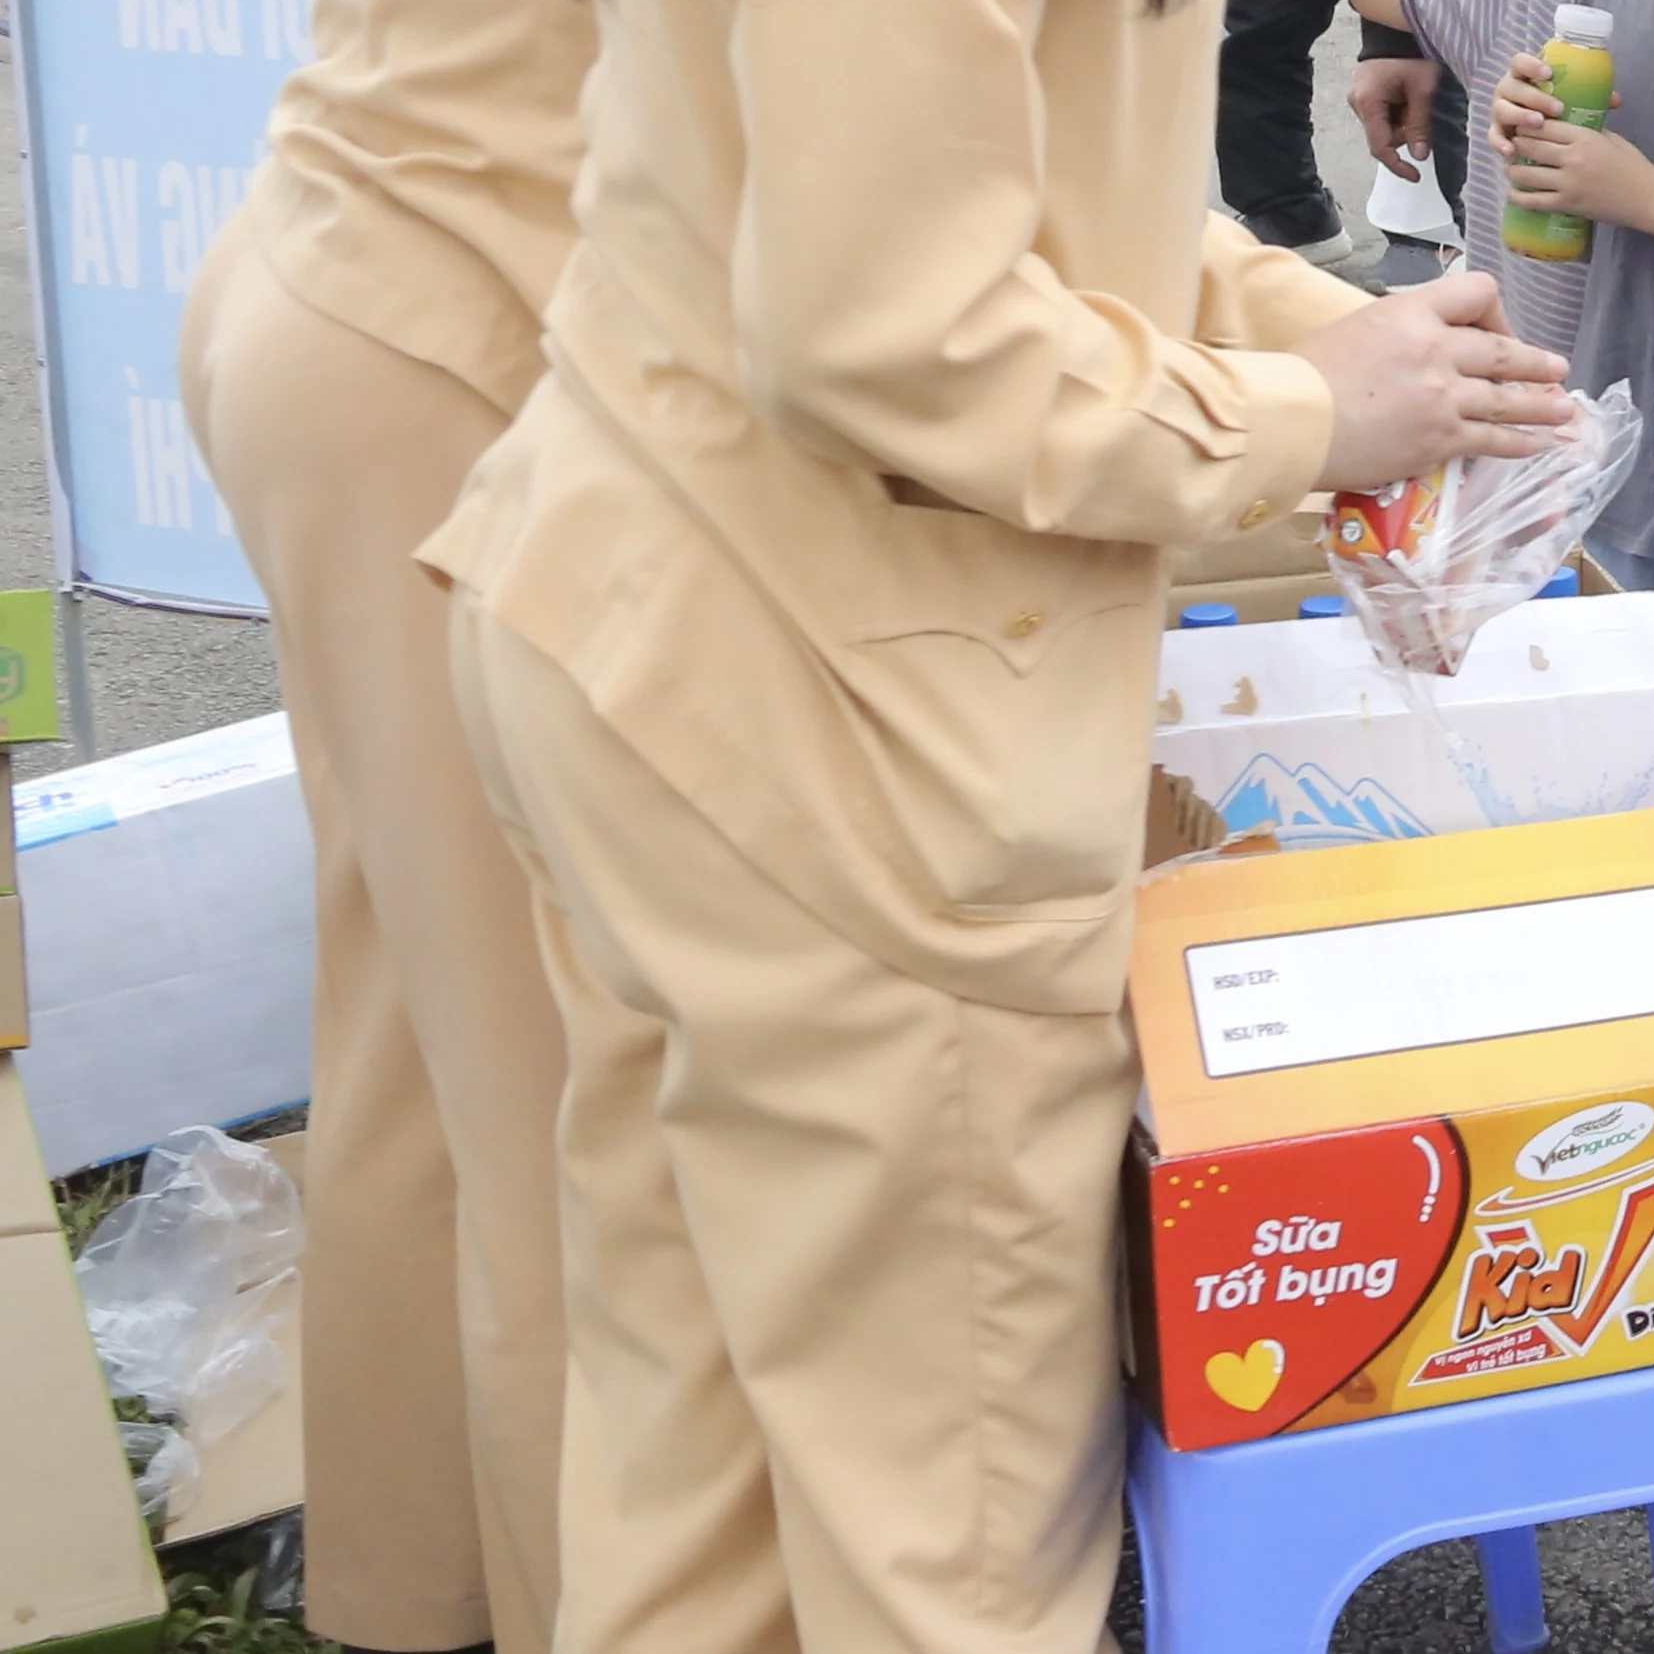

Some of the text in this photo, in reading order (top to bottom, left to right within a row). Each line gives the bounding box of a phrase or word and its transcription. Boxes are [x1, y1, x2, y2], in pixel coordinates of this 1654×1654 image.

[1250, 1215, 1343, 1257] Sữa
[1193, 1257, 1399, 1313] Tốt bụng
[1456, 1245, 1584, 1342] Kid
